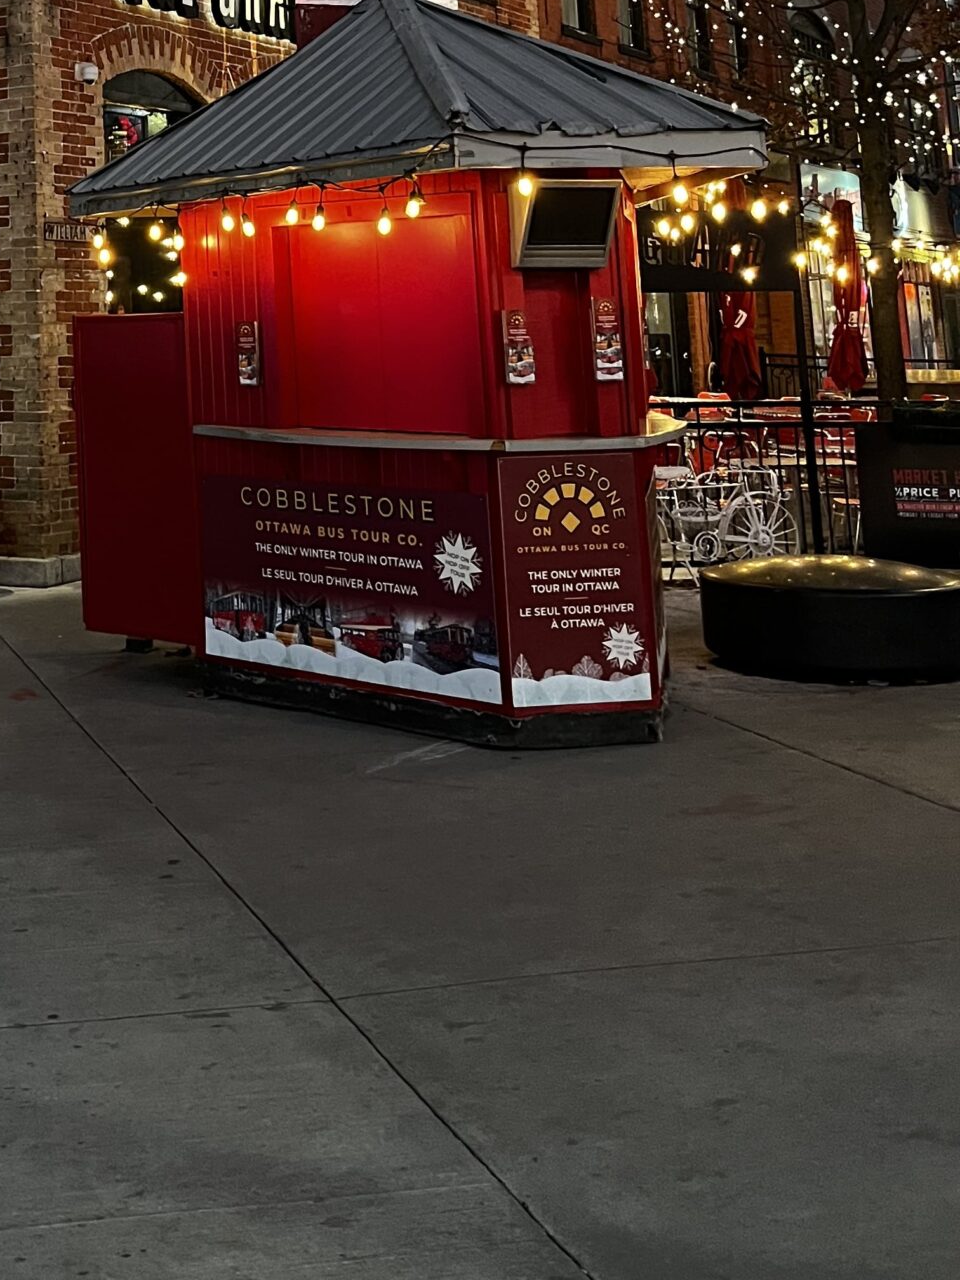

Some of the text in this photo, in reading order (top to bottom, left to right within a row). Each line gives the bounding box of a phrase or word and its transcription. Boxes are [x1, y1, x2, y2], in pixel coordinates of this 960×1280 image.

[893, 469, 948, 486] MARKET
[514, 462, 626, 523] COBBLESTONE
[240, 486, 434, 522] COBBLESTONE
[255, 520, 423, 547] OTTAWA BUS TOUR CO.
[532, 526, 552, 537] ON
[591, 524, 610, 536] QC
[255, 542, 424, 570] THE ONLY WINTER TOUR IN OTTAWA
[517, 545, 558, 554] OTTAWA
[561, 544, 580, 552] BUS
[583, 543, 609, 551] TOUR
[261, 567, 419, 596] LE SEUL TOUR D'HIVER À OTTAWA
[528, 567, 621, 581] THE ONLY WINTER
[531, 581, 620, 594] TOUR IN OTTAWA
[519, 603, 635, 618] LE SEUL TOUR D'HIVER
[551, 618, 605, 629] À OTTAWA
